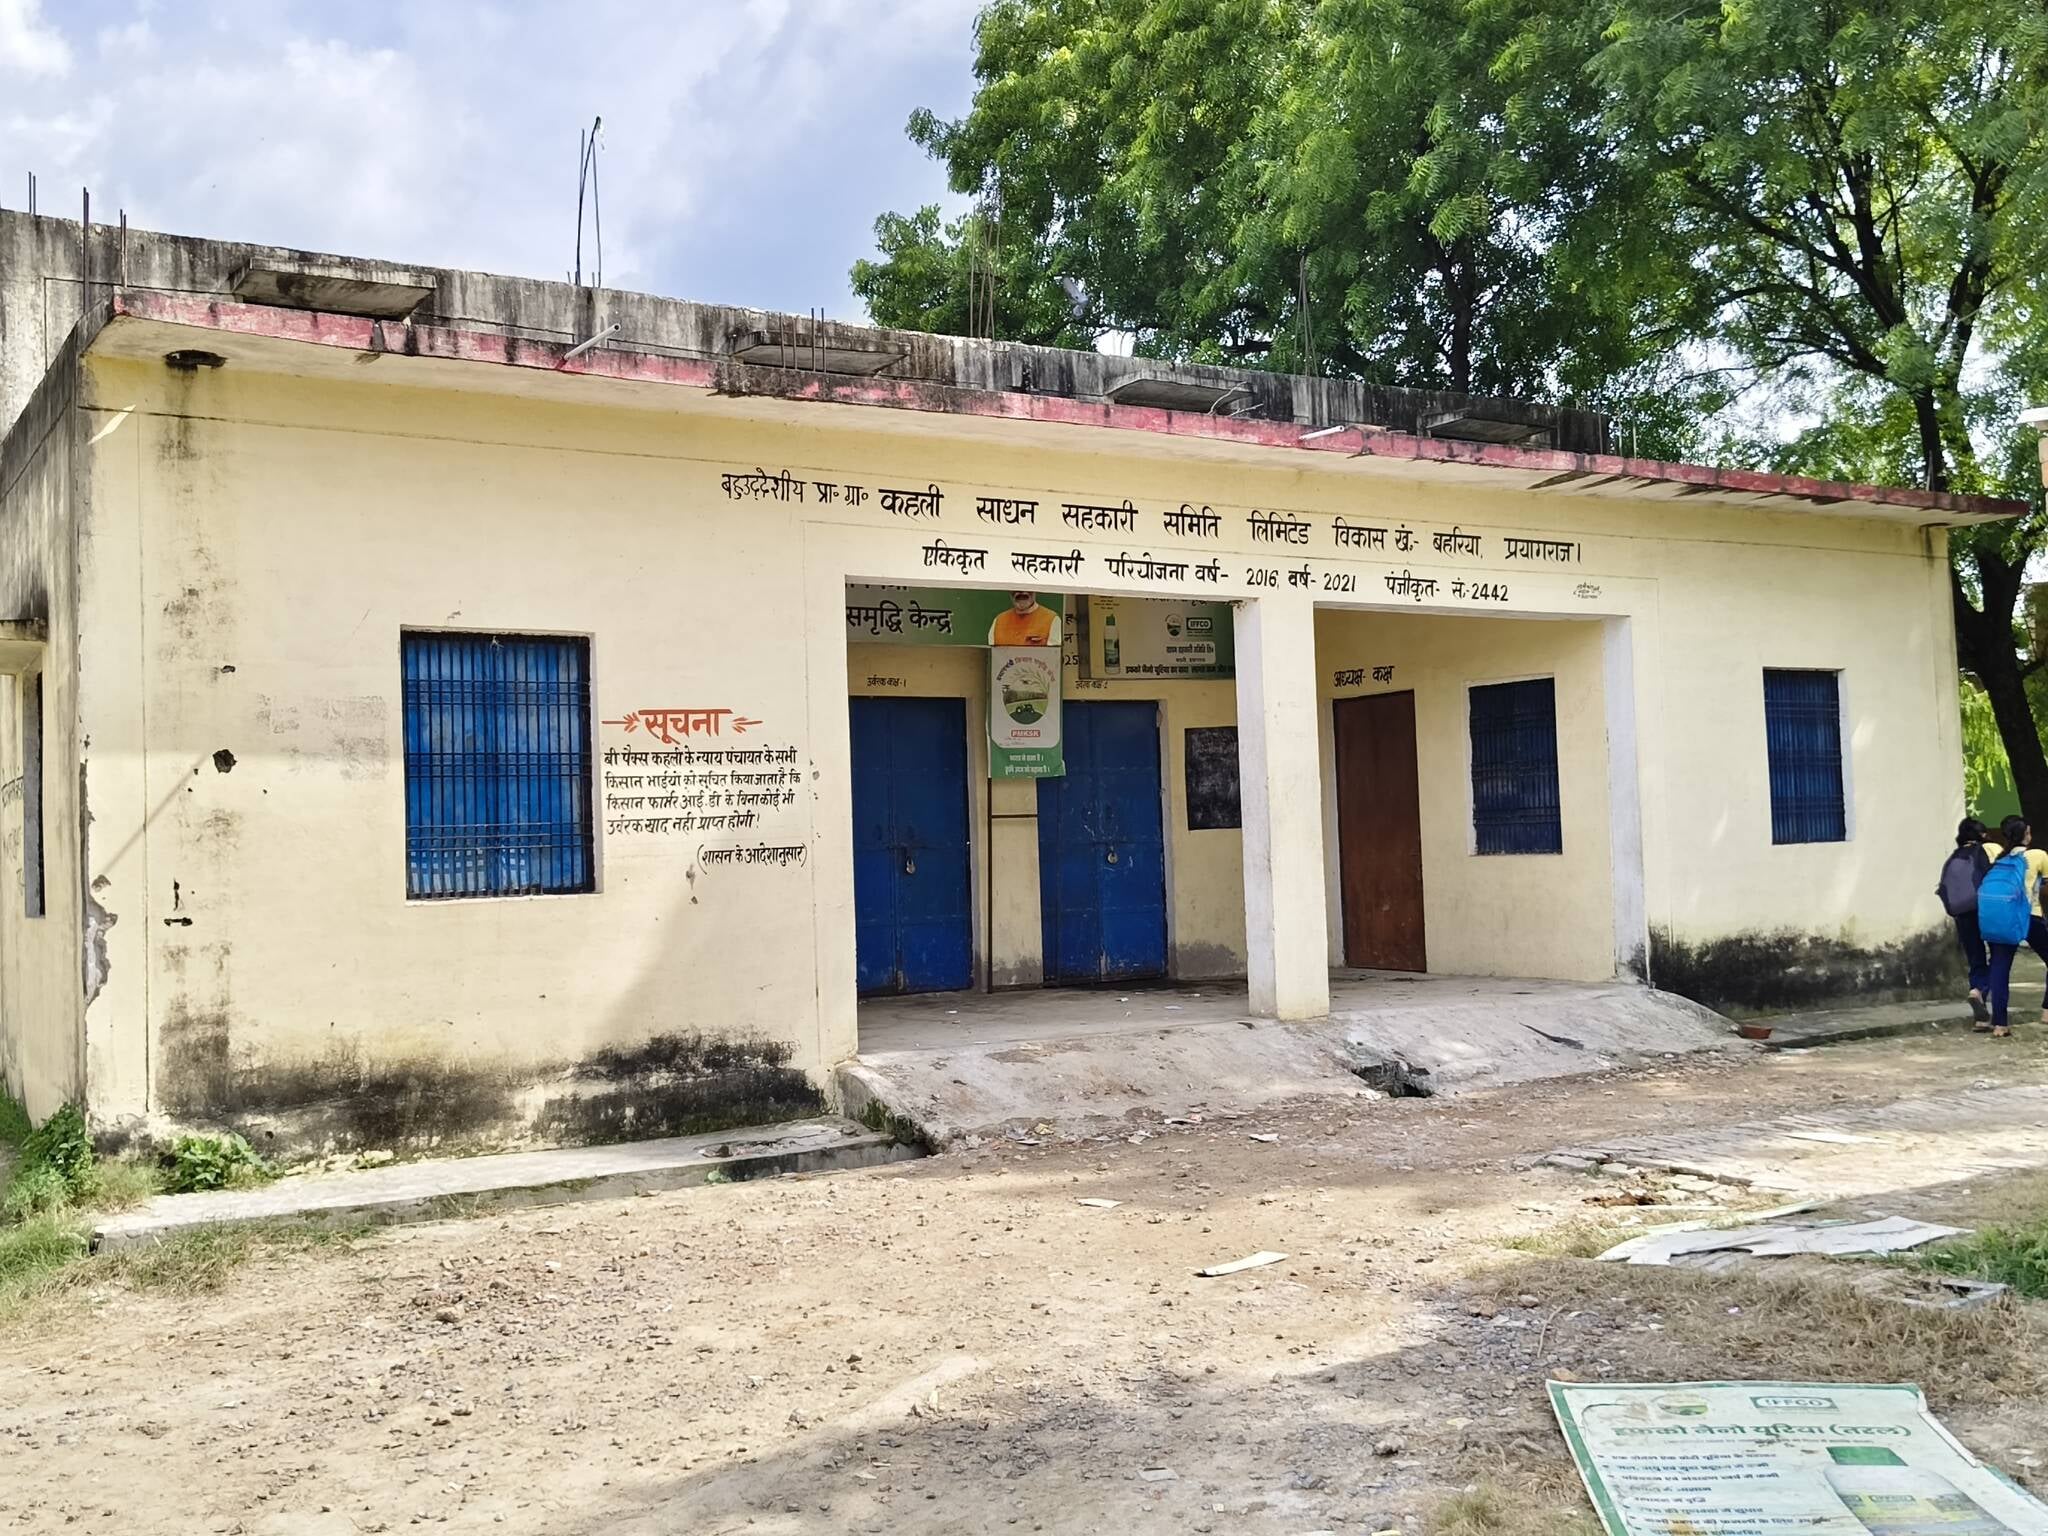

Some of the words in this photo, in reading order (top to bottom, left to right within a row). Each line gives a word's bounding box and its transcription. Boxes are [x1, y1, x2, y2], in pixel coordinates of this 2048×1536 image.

[878, 484, 944, 522] कहली
[976, 497, 1039, 525] साधन
[1061, 499, 1138, 535] सहकारी
[1163, 503, 1222, 538] समिति
[1246, 509, 1312, 545] लिमिटेड
[1332, 516, 1388, 552] विकास
[922, 539, 989, 575] एकिकृत
[1011, 549, 1085, 580] सहकारी
[1104, 552, 1189, 582] परियोजना
[1323, 573, 1356, 593] 2021
[846, 600, 903, 635] समृद्धि
[908, 600, 952, 634] केन्द्र
[1189, 619, 1210, 629] IFFCO
[638, 708, 733, 745] सूचना
[621, 744, 649, 766] पैक्स
[684, 744, 695, 766] के
[696, 751, 724, 765] न्याय
[725, 746, 763, 765] पंचायत
[763, 744, 774, 764] के
[775, 745, 798, 764] सभी
[604, 771, 644, 790] किसान
[606, 793, 645, 810] किसान
